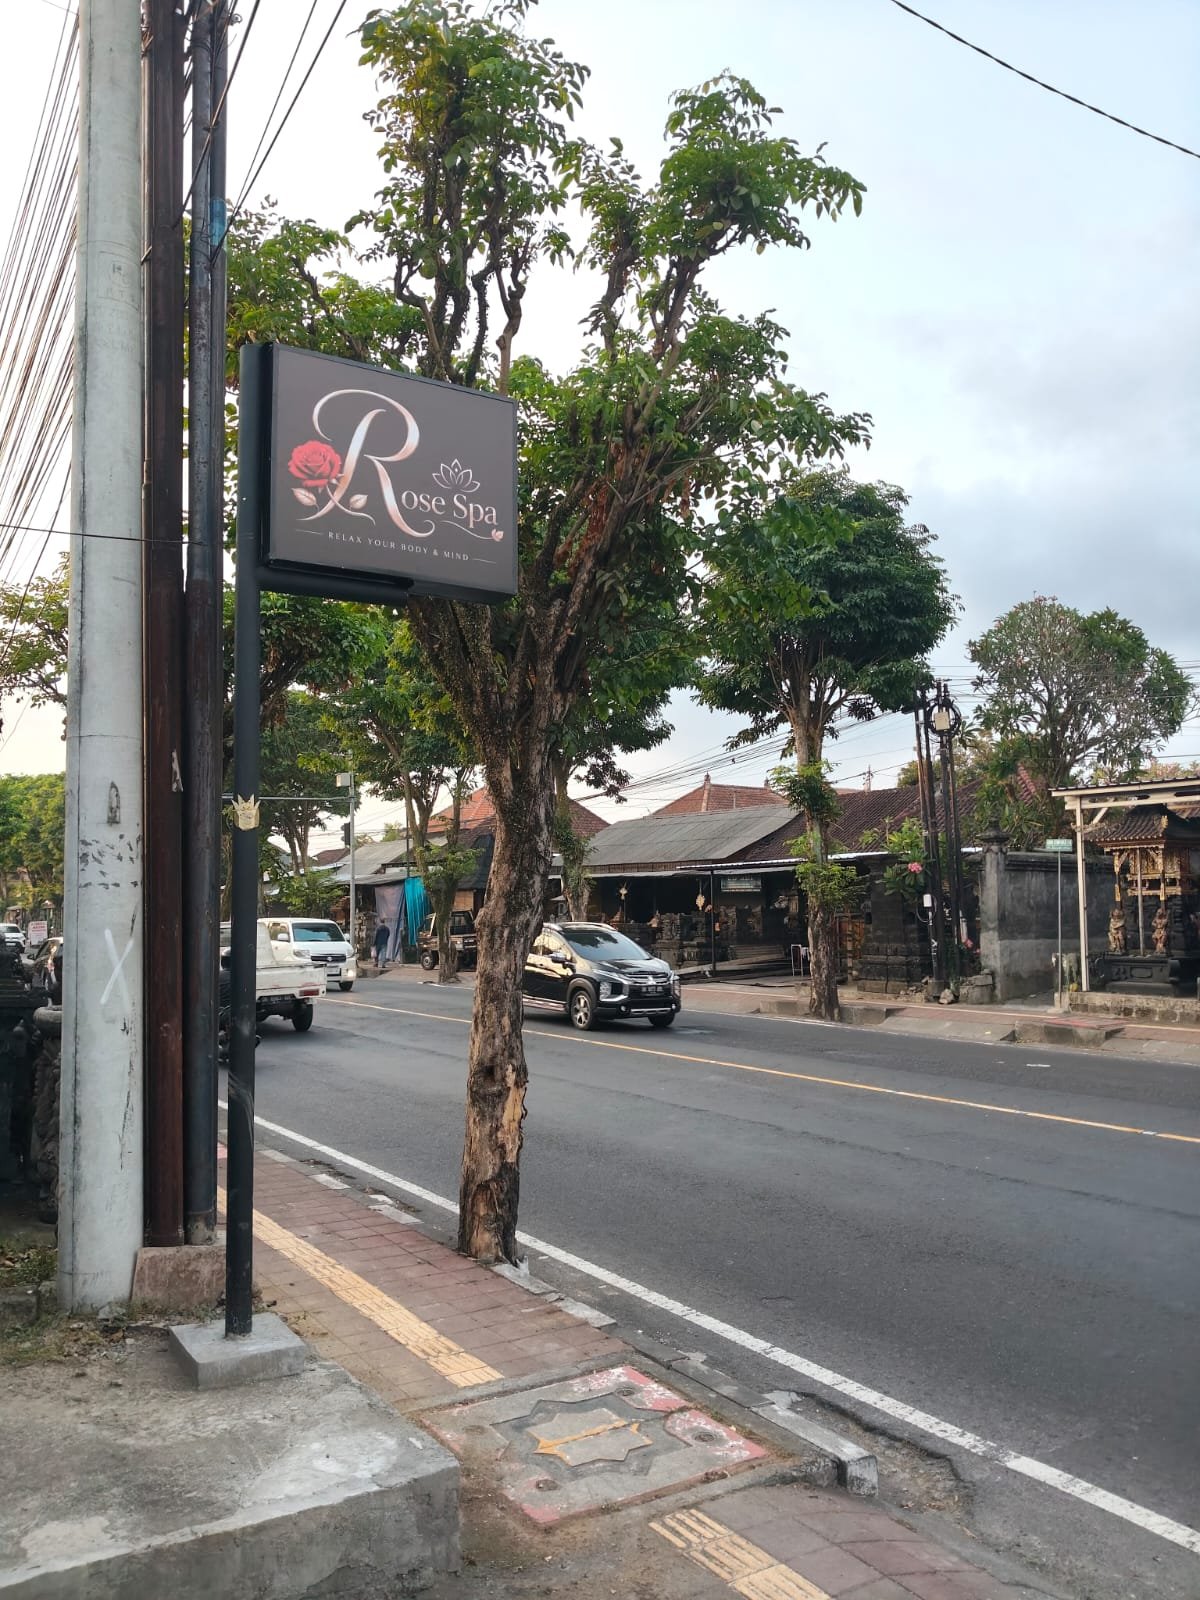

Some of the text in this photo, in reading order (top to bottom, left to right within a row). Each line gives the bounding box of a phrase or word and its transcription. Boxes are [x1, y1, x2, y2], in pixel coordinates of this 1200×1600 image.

[296, 389, 499, 538] Rose Spa
[328, 531, 469, 561] RELAX YOUR BODY & MIND
